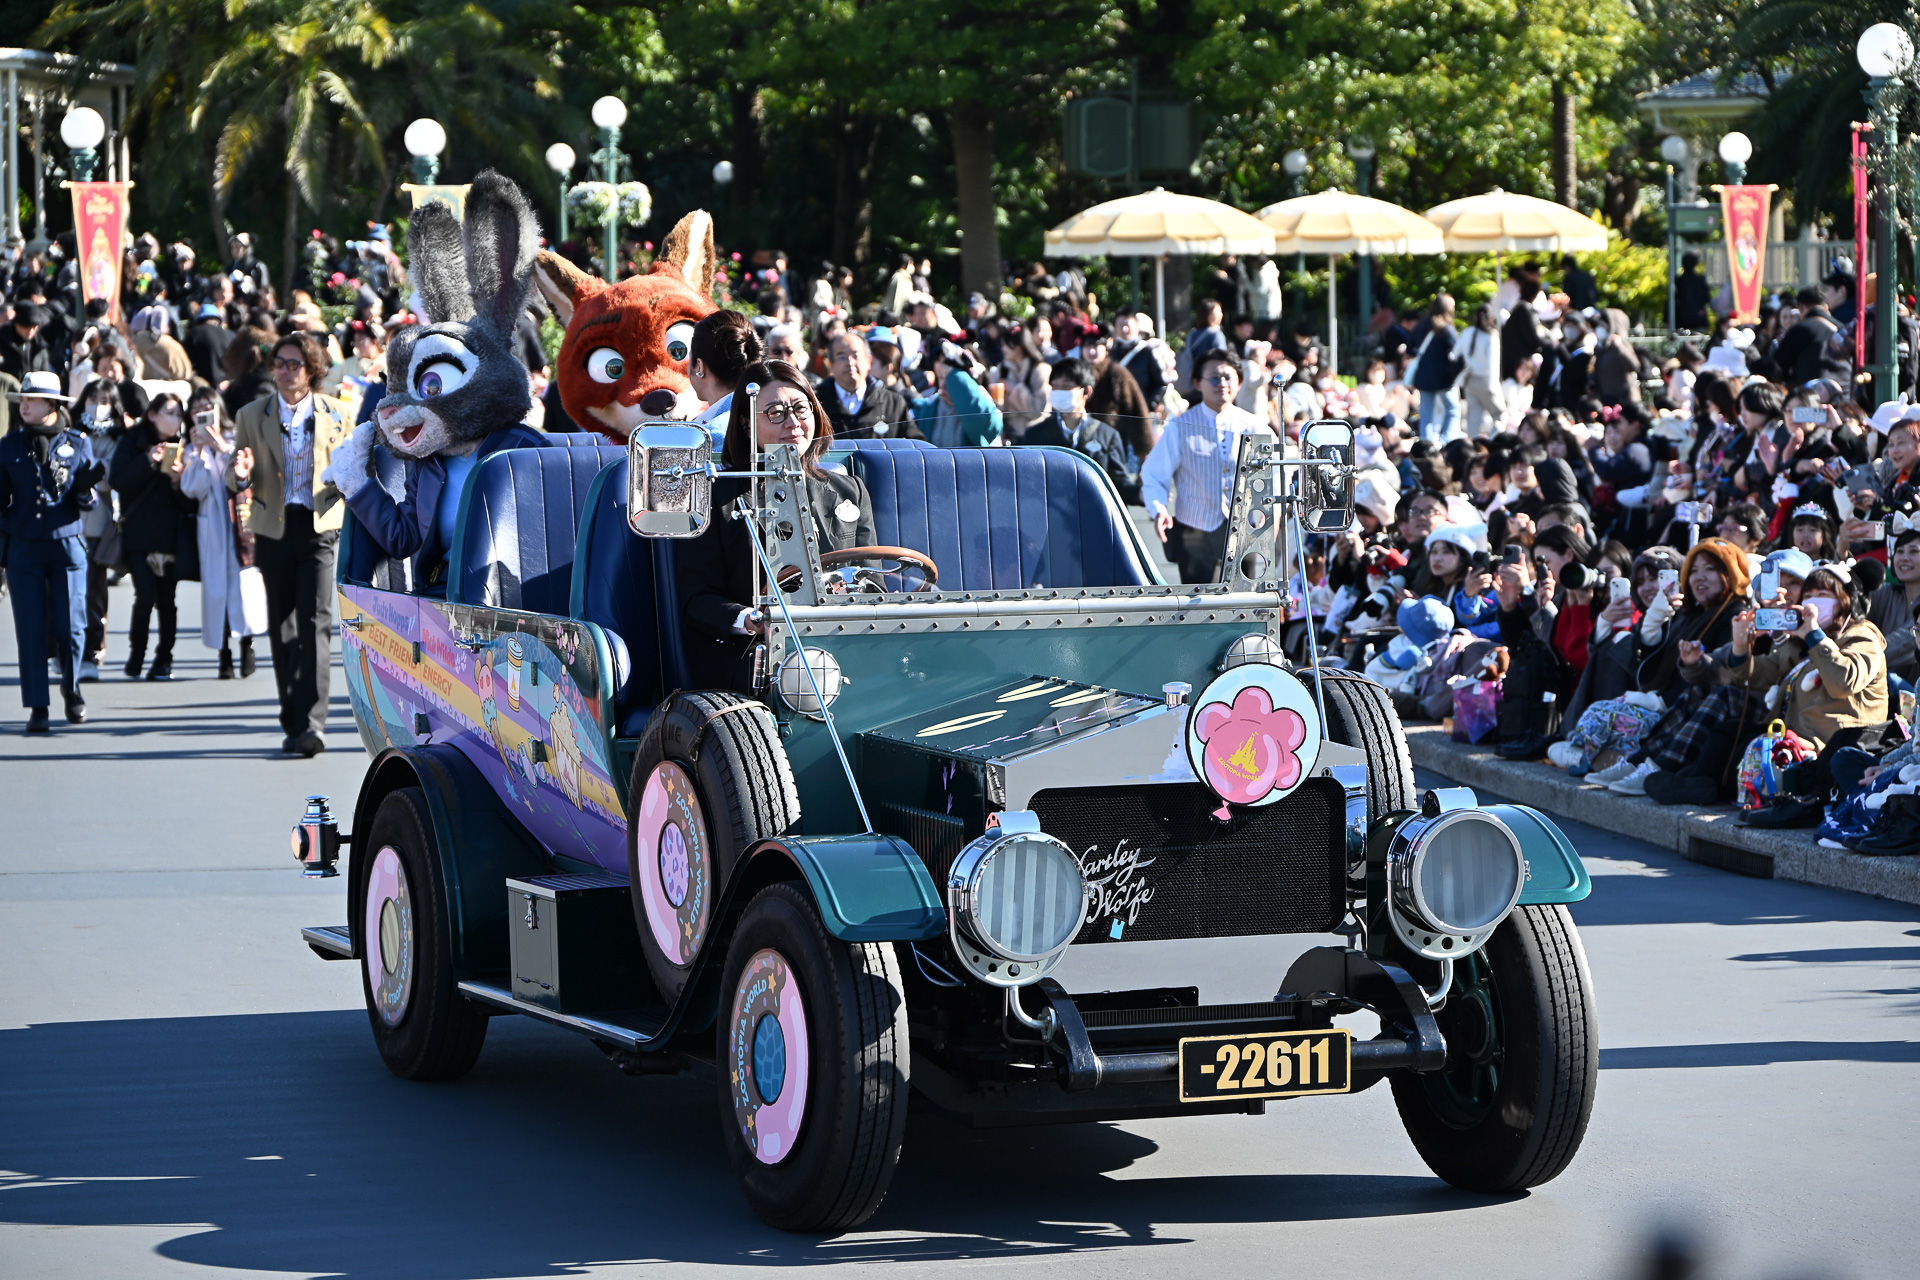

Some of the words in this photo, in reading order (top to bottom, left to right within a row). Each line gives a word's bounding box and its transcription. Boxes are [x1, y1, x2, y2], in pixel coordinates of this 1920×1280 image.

[373, 596, 388, 618] Judy
[389, 603, 409, 632] Hopps
[369, 624, 388, 648] BEST
[423, 664, 452, 696] ENERGY
[422, 628, 436, 655] Nick
[437, 638, 456, 668] Wilde
[1218, 757, 1241, 777] ZOOTOPIA
[675, 791, 701, 865] ZOOTOPIA
[690, 868, 703, 924] WORLD
[743, 978, 767, 1014] WORLD
[738, 1019, 750, 1107] ZOOTOPIA
[1200, 1037, 1330, 1091] -22611
